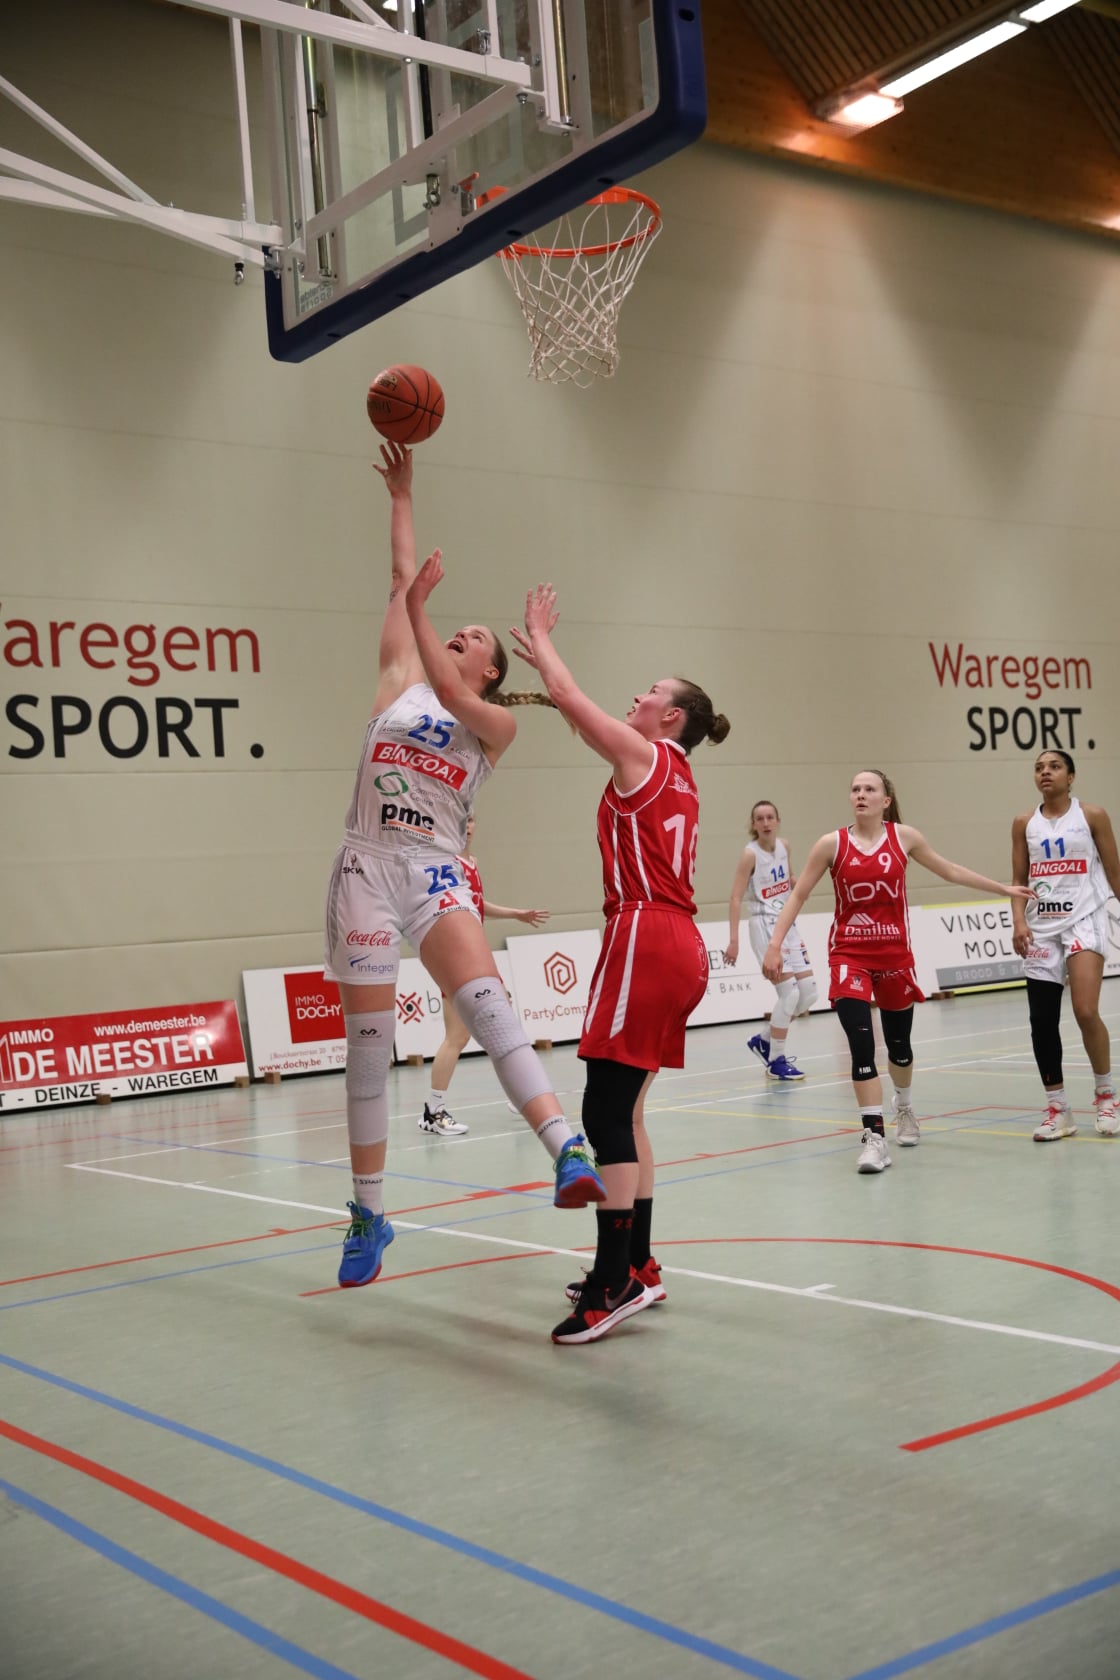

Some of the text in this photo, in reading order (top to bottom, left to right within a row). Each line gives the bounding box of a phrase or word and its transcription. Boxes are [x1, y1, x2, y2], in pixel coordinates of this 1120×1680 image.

[0, 603, 261, 687] aregem
[928, 641, 1092, 700] Waregem
[5, 694, 265, 759] SPORT.
[408, 714, 454, 749] 25
[967, 706, 1096, 752] SPORT.
[381, 802, 435, 831] pmc
[1041, 837, 1066, 859] 11
[771, 864, 785, 882] 14
[878, 852, 892, 874] 9
[424, 864, 459, 896] 25
[1037, 901, 1073, 916] pmc
[845, 922, 900, 935] Danilith
[941, 911, 1012, 933] VINCE
[964, 939, 1012, 960] MOL
[295, 994, 325, 1006] IMMO
[296, 1004, 341, 1020] DOCHY
[9, 1027, 54, 1045] IMMO
[94, 1013, 207, 1037] www.demeester.be
[12, 1032, 214, 1082] DE MEESTER
[258, 1058, 321, 1073] www.dochy.be
[35, 1082, 101, 1103] DEINZE
[128, 1068, 219, 1092] WAREGEM
